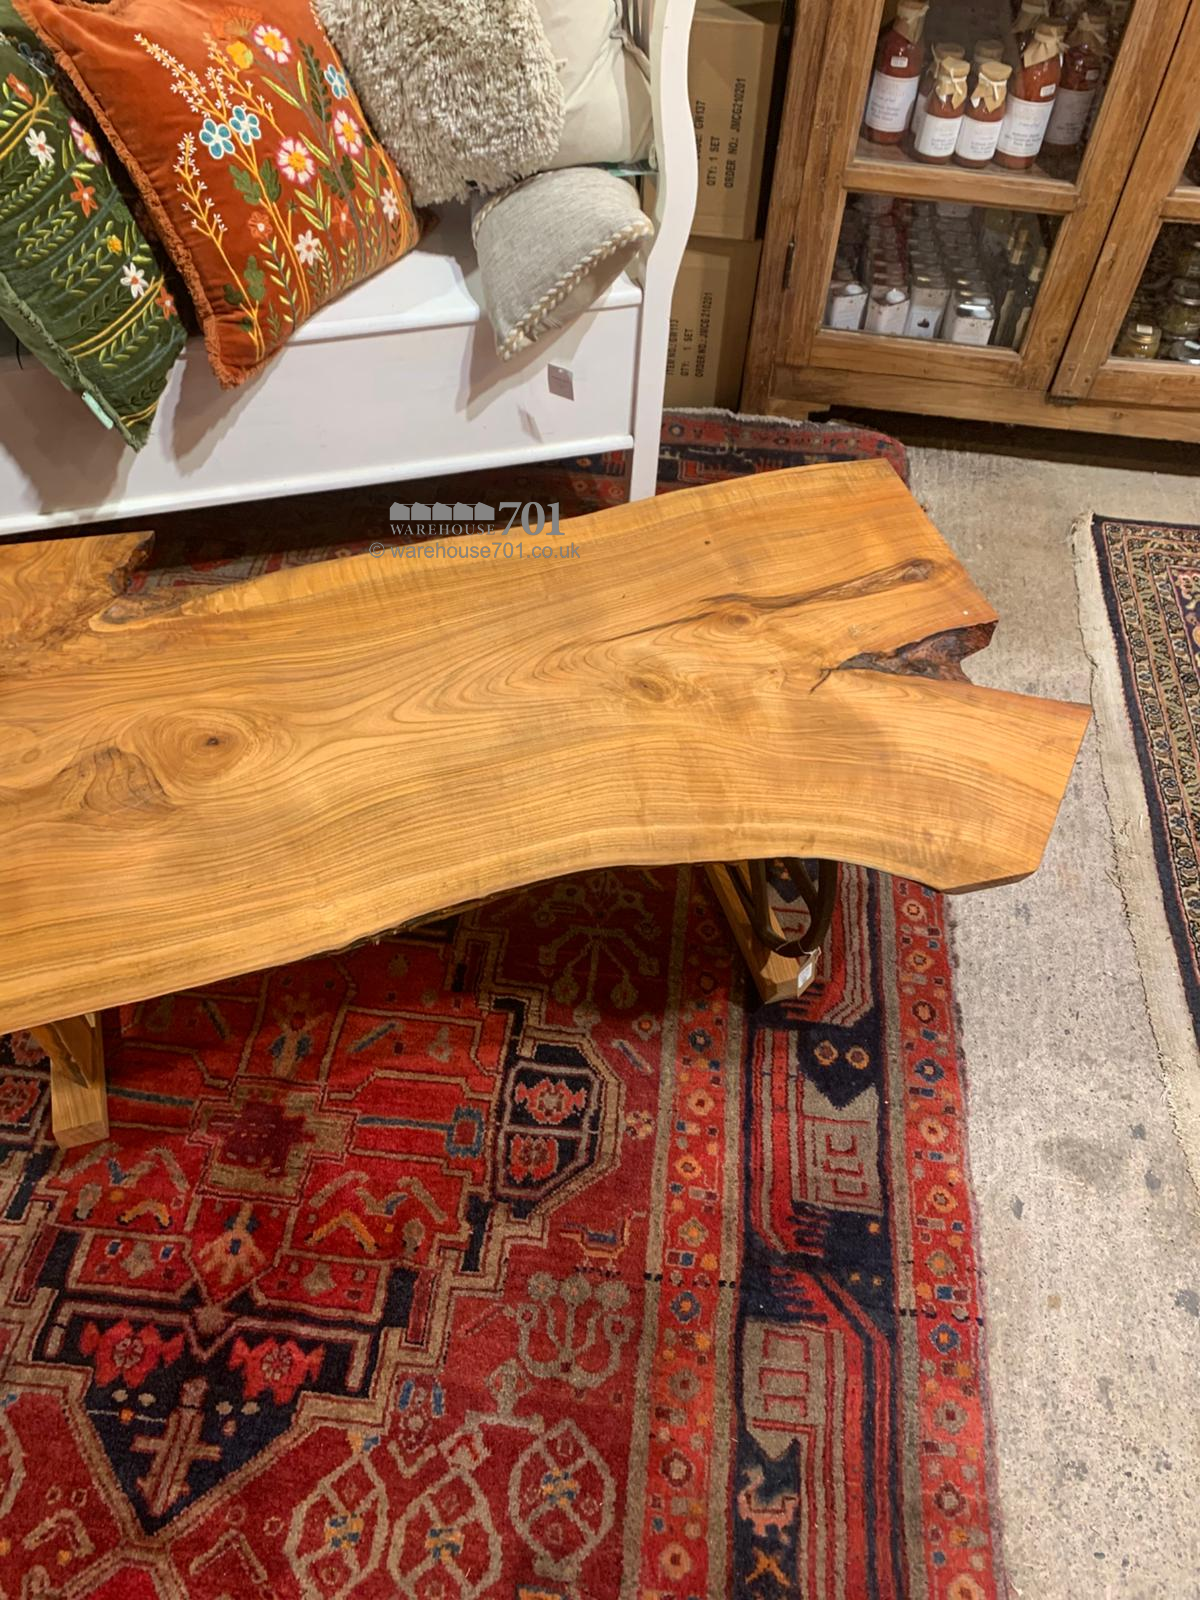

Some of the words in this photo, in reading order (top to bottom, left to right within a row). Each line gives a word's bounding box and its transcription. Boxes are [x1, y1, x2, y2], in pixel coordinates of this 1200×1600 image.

[730, 78, 746, 133] JMCG210201
[709, 135, 720, 153] SET
[727, 137, 739, 156] NO.:
[706, 166, 717, 187] QTY:
[724, 159, 736, 189] ORDER
[684, 328, 693, 342] SET
[680, 360, 690, 376] QTY:
[695, 356, 705, 377] ORDER
